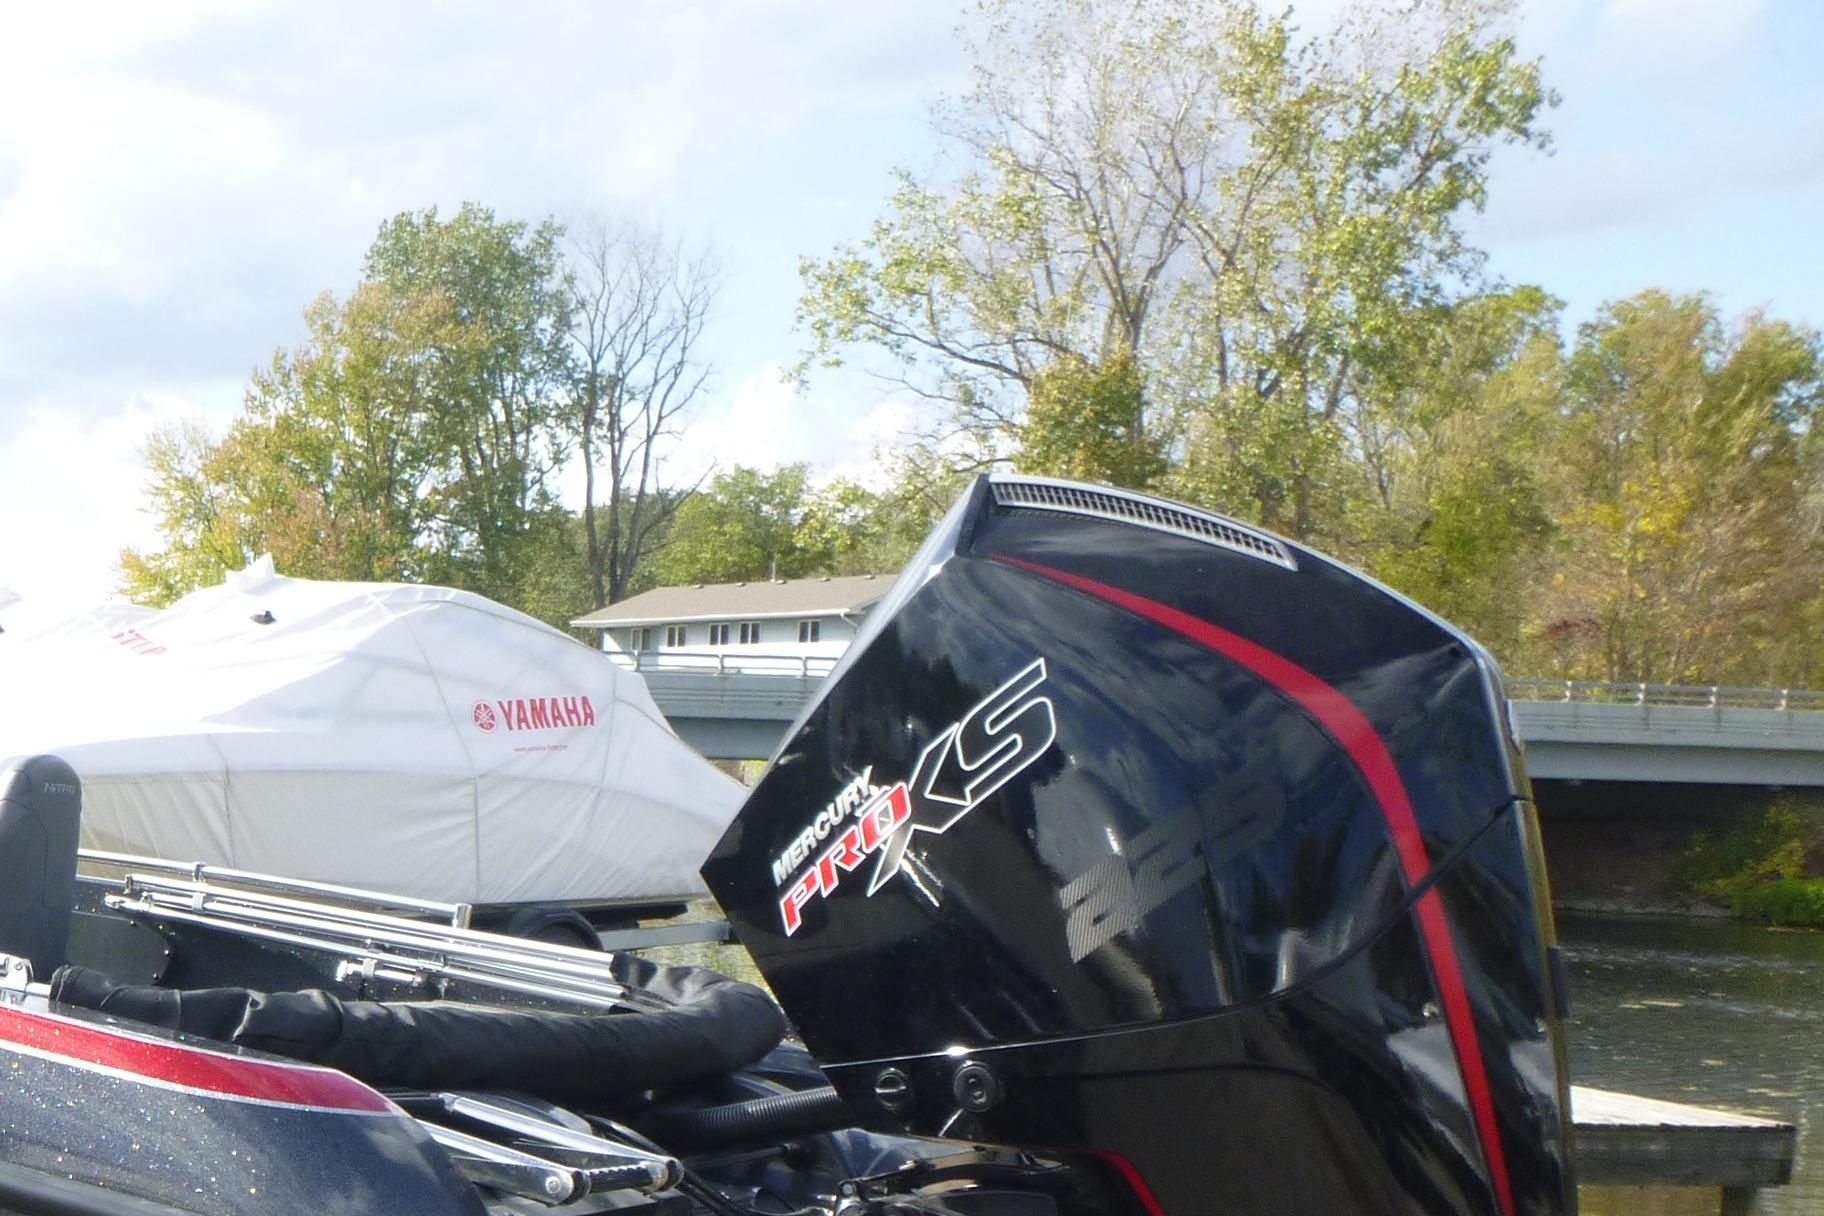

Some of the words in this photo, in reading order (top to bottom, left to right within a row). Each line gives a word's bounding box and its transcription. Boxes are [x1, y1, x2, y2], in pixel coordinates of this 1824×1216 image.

[496, 695, 596, 732] YAMAHA
[770, 764, 874, 888] MERCURY
[778, 780, 912, 938] PRO
